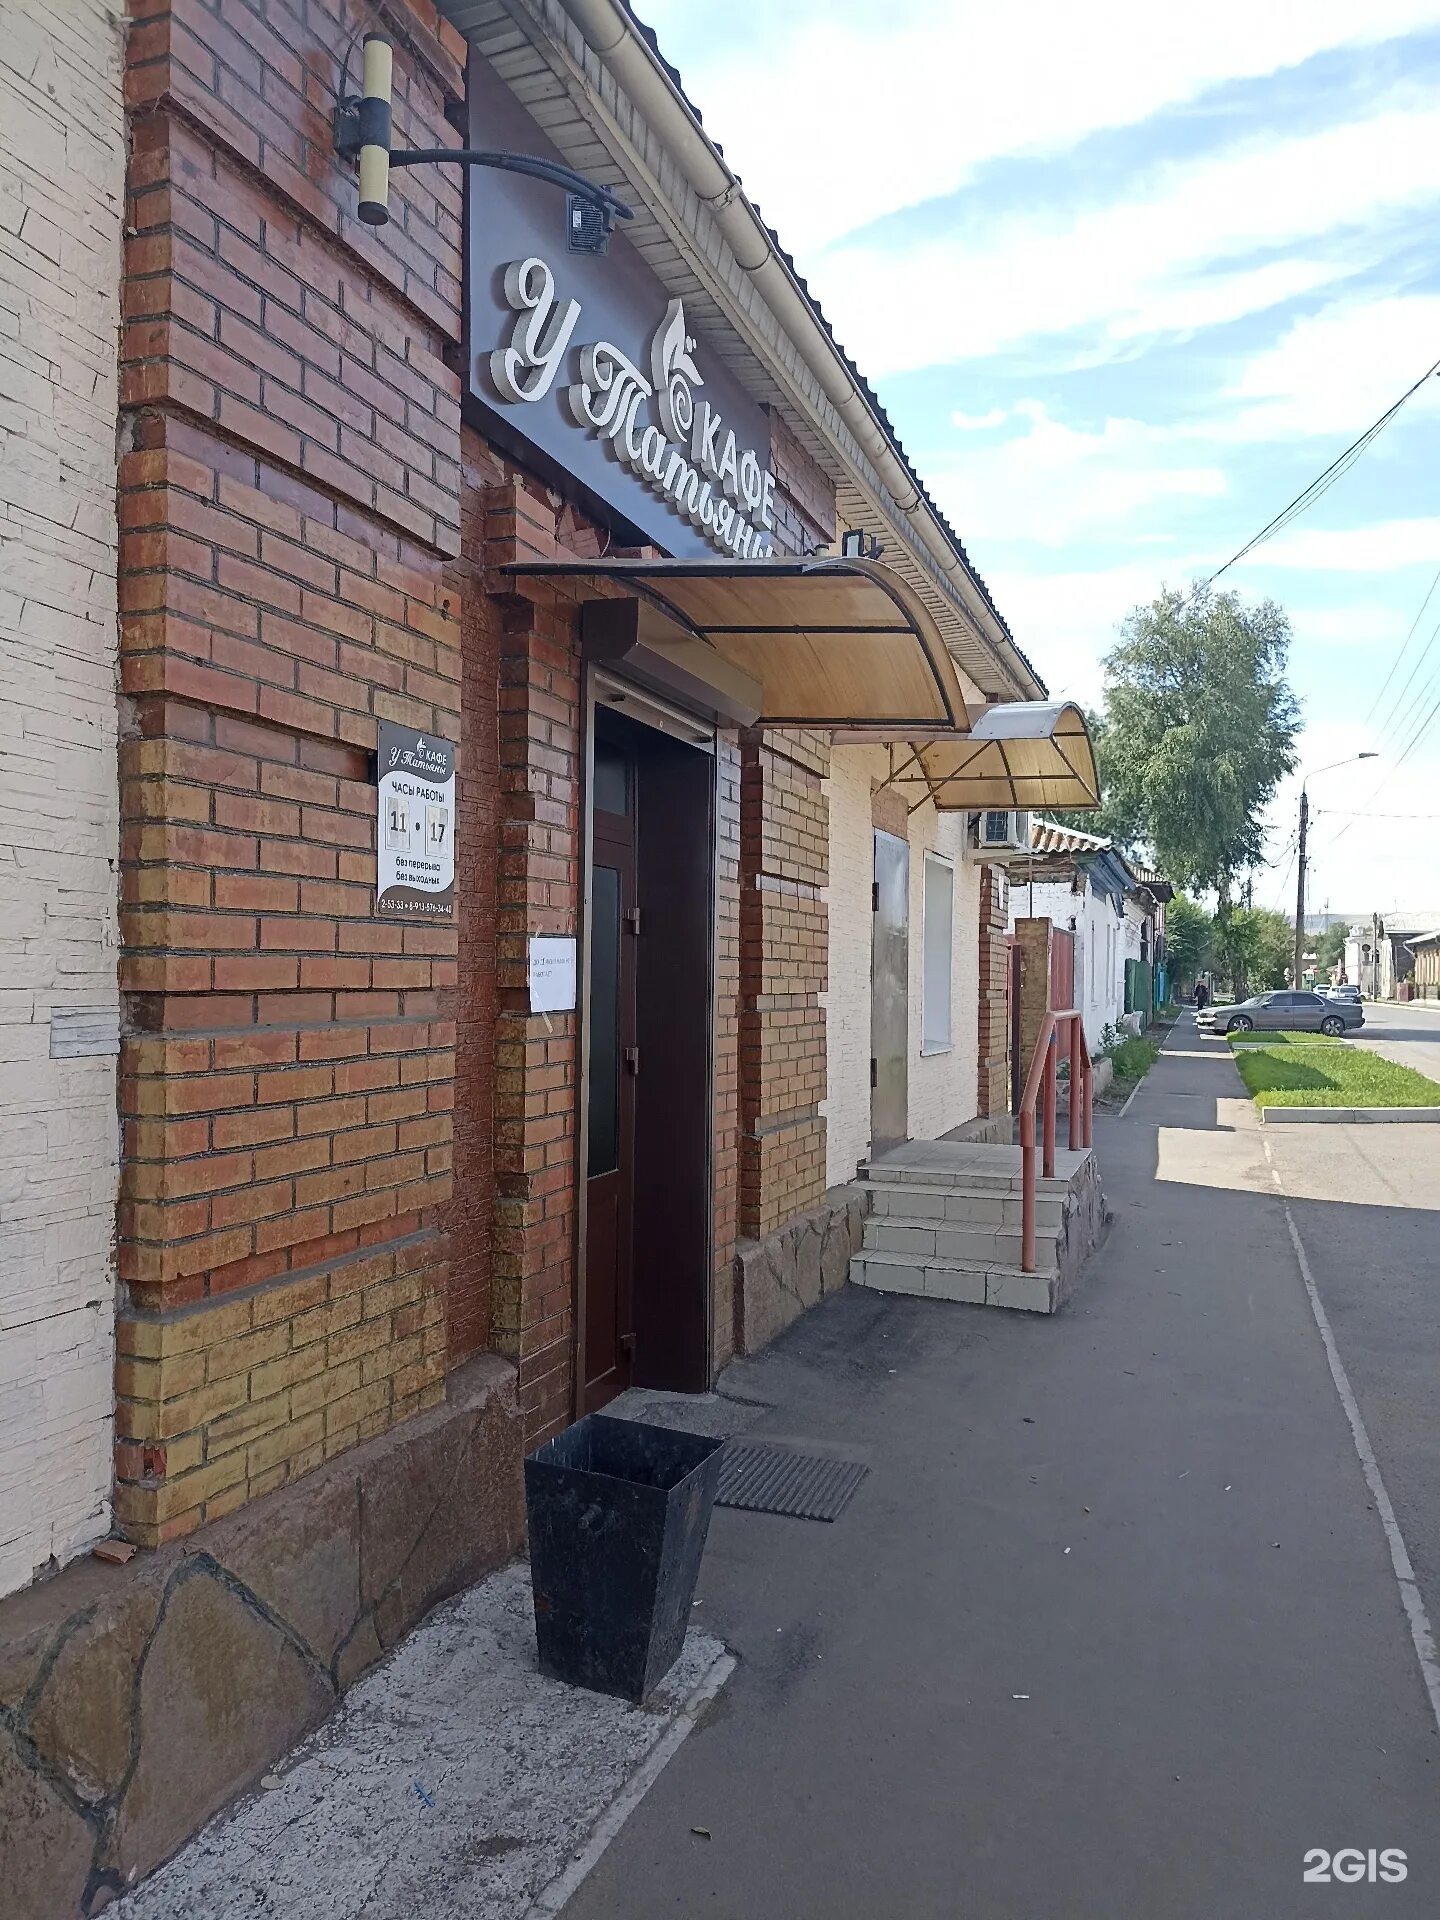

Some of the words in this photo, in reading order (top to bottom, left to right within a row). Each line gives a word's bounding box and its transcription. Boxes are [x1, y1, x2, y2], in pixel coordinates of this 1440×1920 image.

[490, 257, 582, 404] У
[691, 400, 776, 531] КАФЕ
[388, 746, 402, 768] У
[401, 750, 447, 775] Татьяны
[425, 749, 447, 766] КАФЕ
[391, 780, 415, 797] ЧАСЫ
[416, 786, 445, 803] РАБОТЫ
[390, 810, 407, 833] 11
[430, 821, 446, 843] 17
[395, 856, 408, 867] без
[408, 859, 441, 872] перерыва
[395, 870, 408, 881] без
[408, 873, 440, 885] выходных
